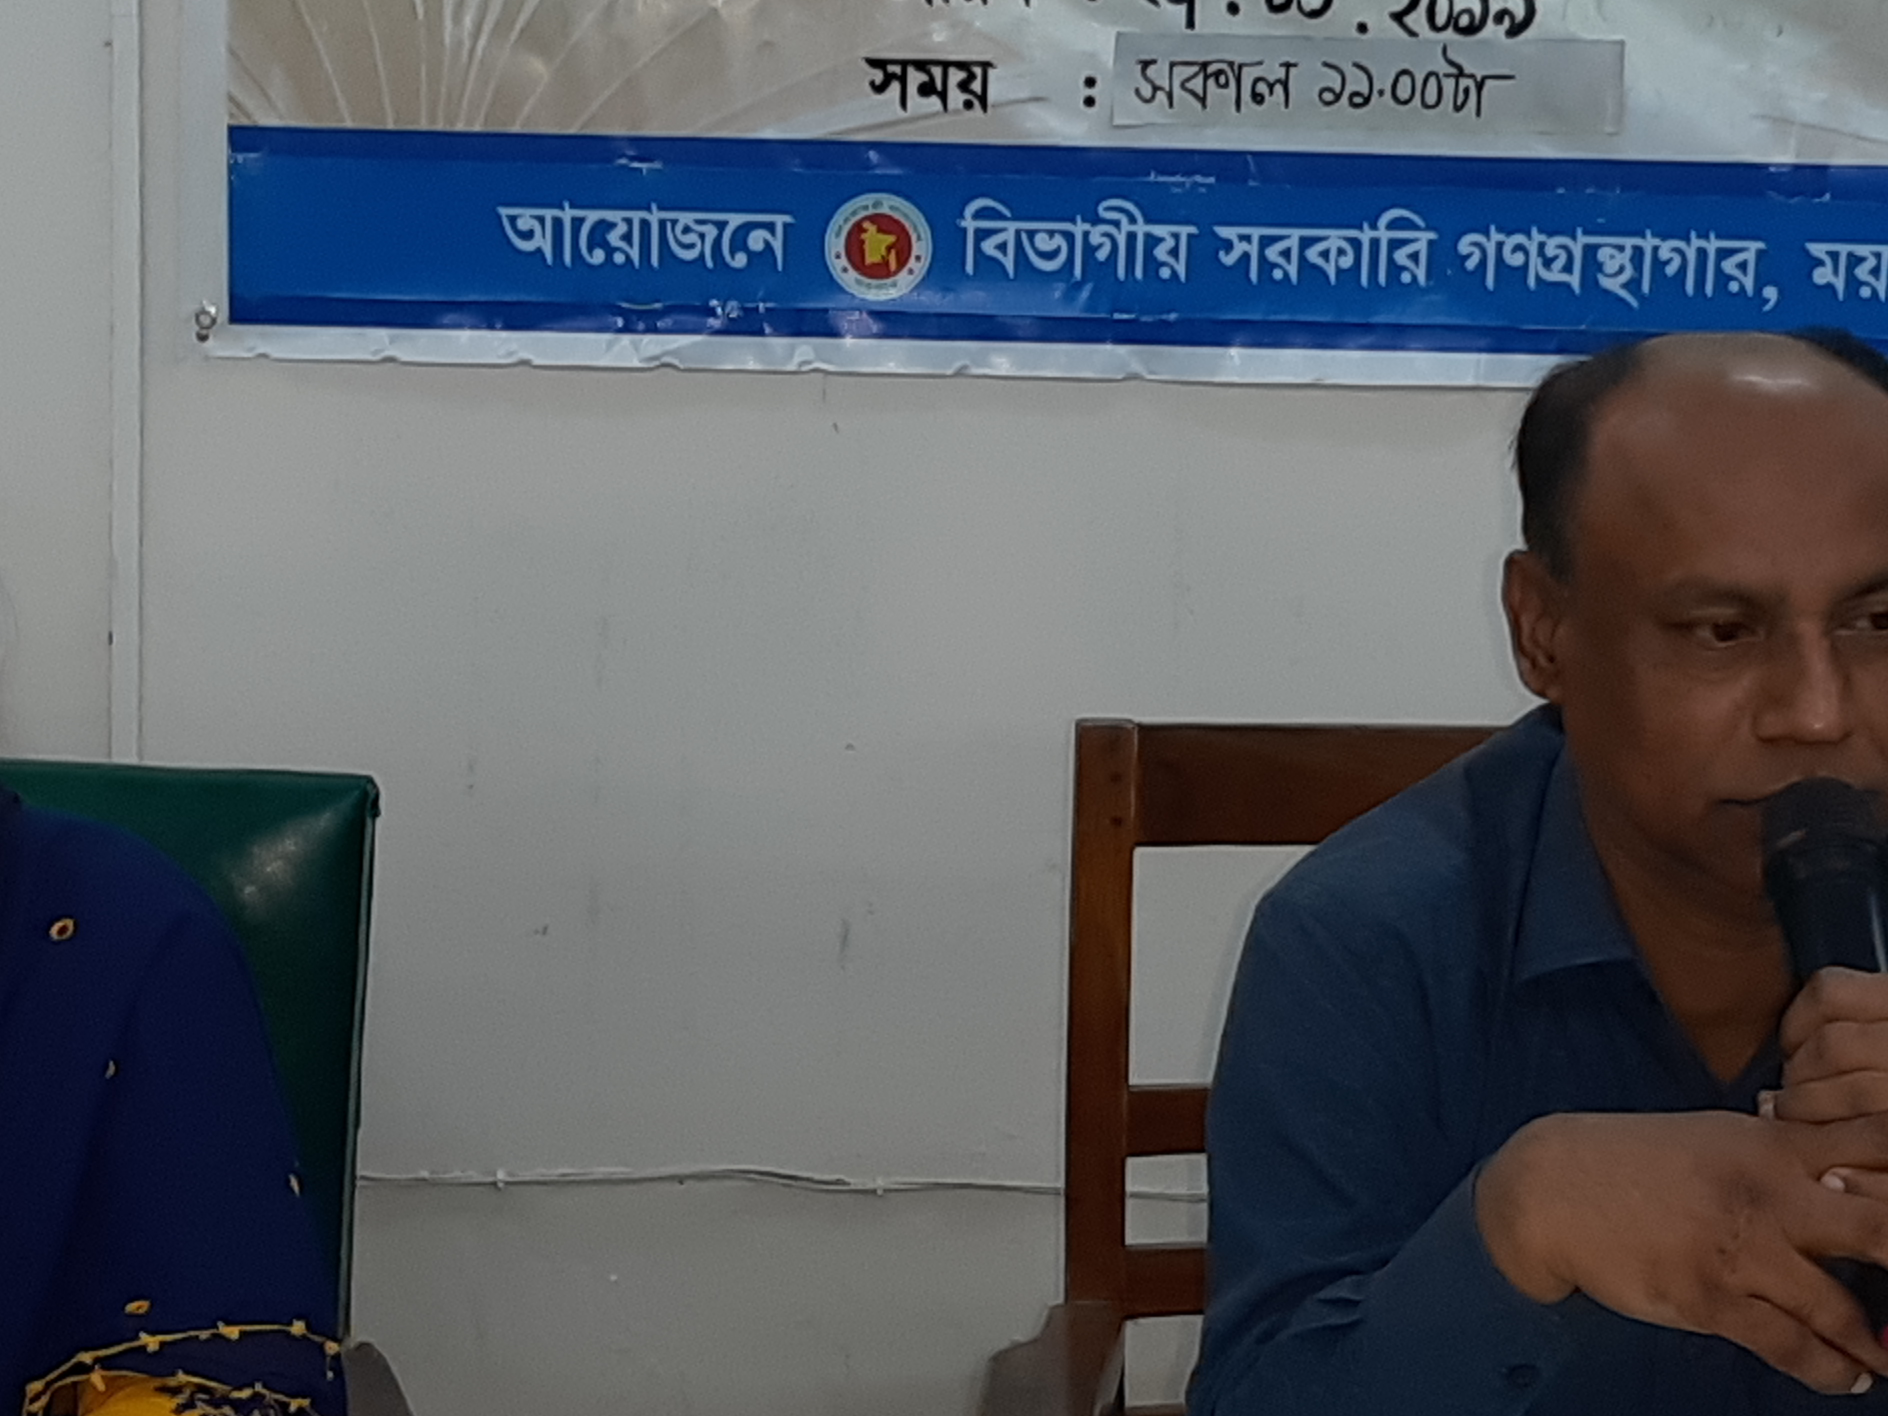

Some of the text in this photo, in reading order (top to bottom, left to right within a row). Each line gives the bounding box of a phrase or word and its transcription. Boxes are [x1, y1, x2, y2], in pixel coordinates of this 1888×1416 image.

[865, 56, 996, 114] সময়
[1133, 57, 1299, 114] সকাল
[497, 199, 796, 272] আয়োজনে
[959, 197, 1197, 284] বিভাগীয়
[1213, 209, 1438, 286] সরকারি
